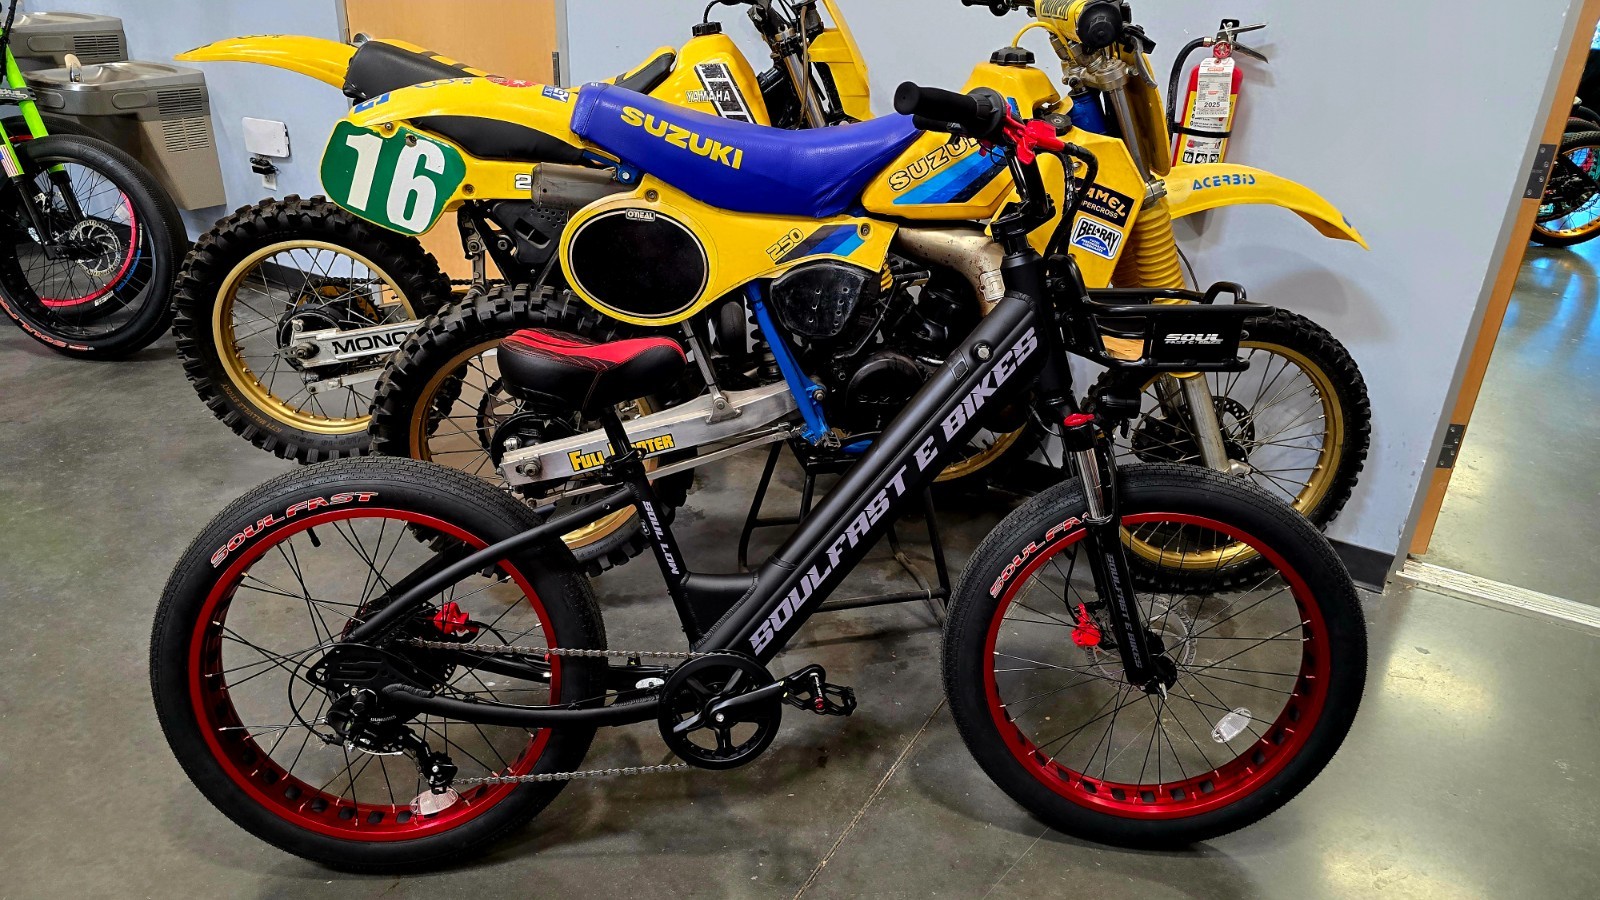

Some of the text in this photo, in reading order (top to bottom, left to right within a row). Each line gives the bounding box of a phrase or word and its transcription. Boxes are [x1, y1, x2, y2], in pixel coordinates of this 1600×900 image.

[686, 90, 732, 103] YAMAHA
[620, 105, 744, 170] SUZUKI
[345, 132, 446, 234] 16
[1085, 186, 1126, 217] AMEL
[1081, 200, 1119, 219] PERCROSS
[765, 228, 804, 262] 250
[1164, 333, 1224, 341] SOUL
[748, 327, 1038, 657] SOULFAST E BIKES
[642, 500, 664, 541] SOUL
[660, 543, 680, 575] LOW
[1105, 552, 1131, 621] SOULFAST
[1127, 632, 1143, 669] BIKES
